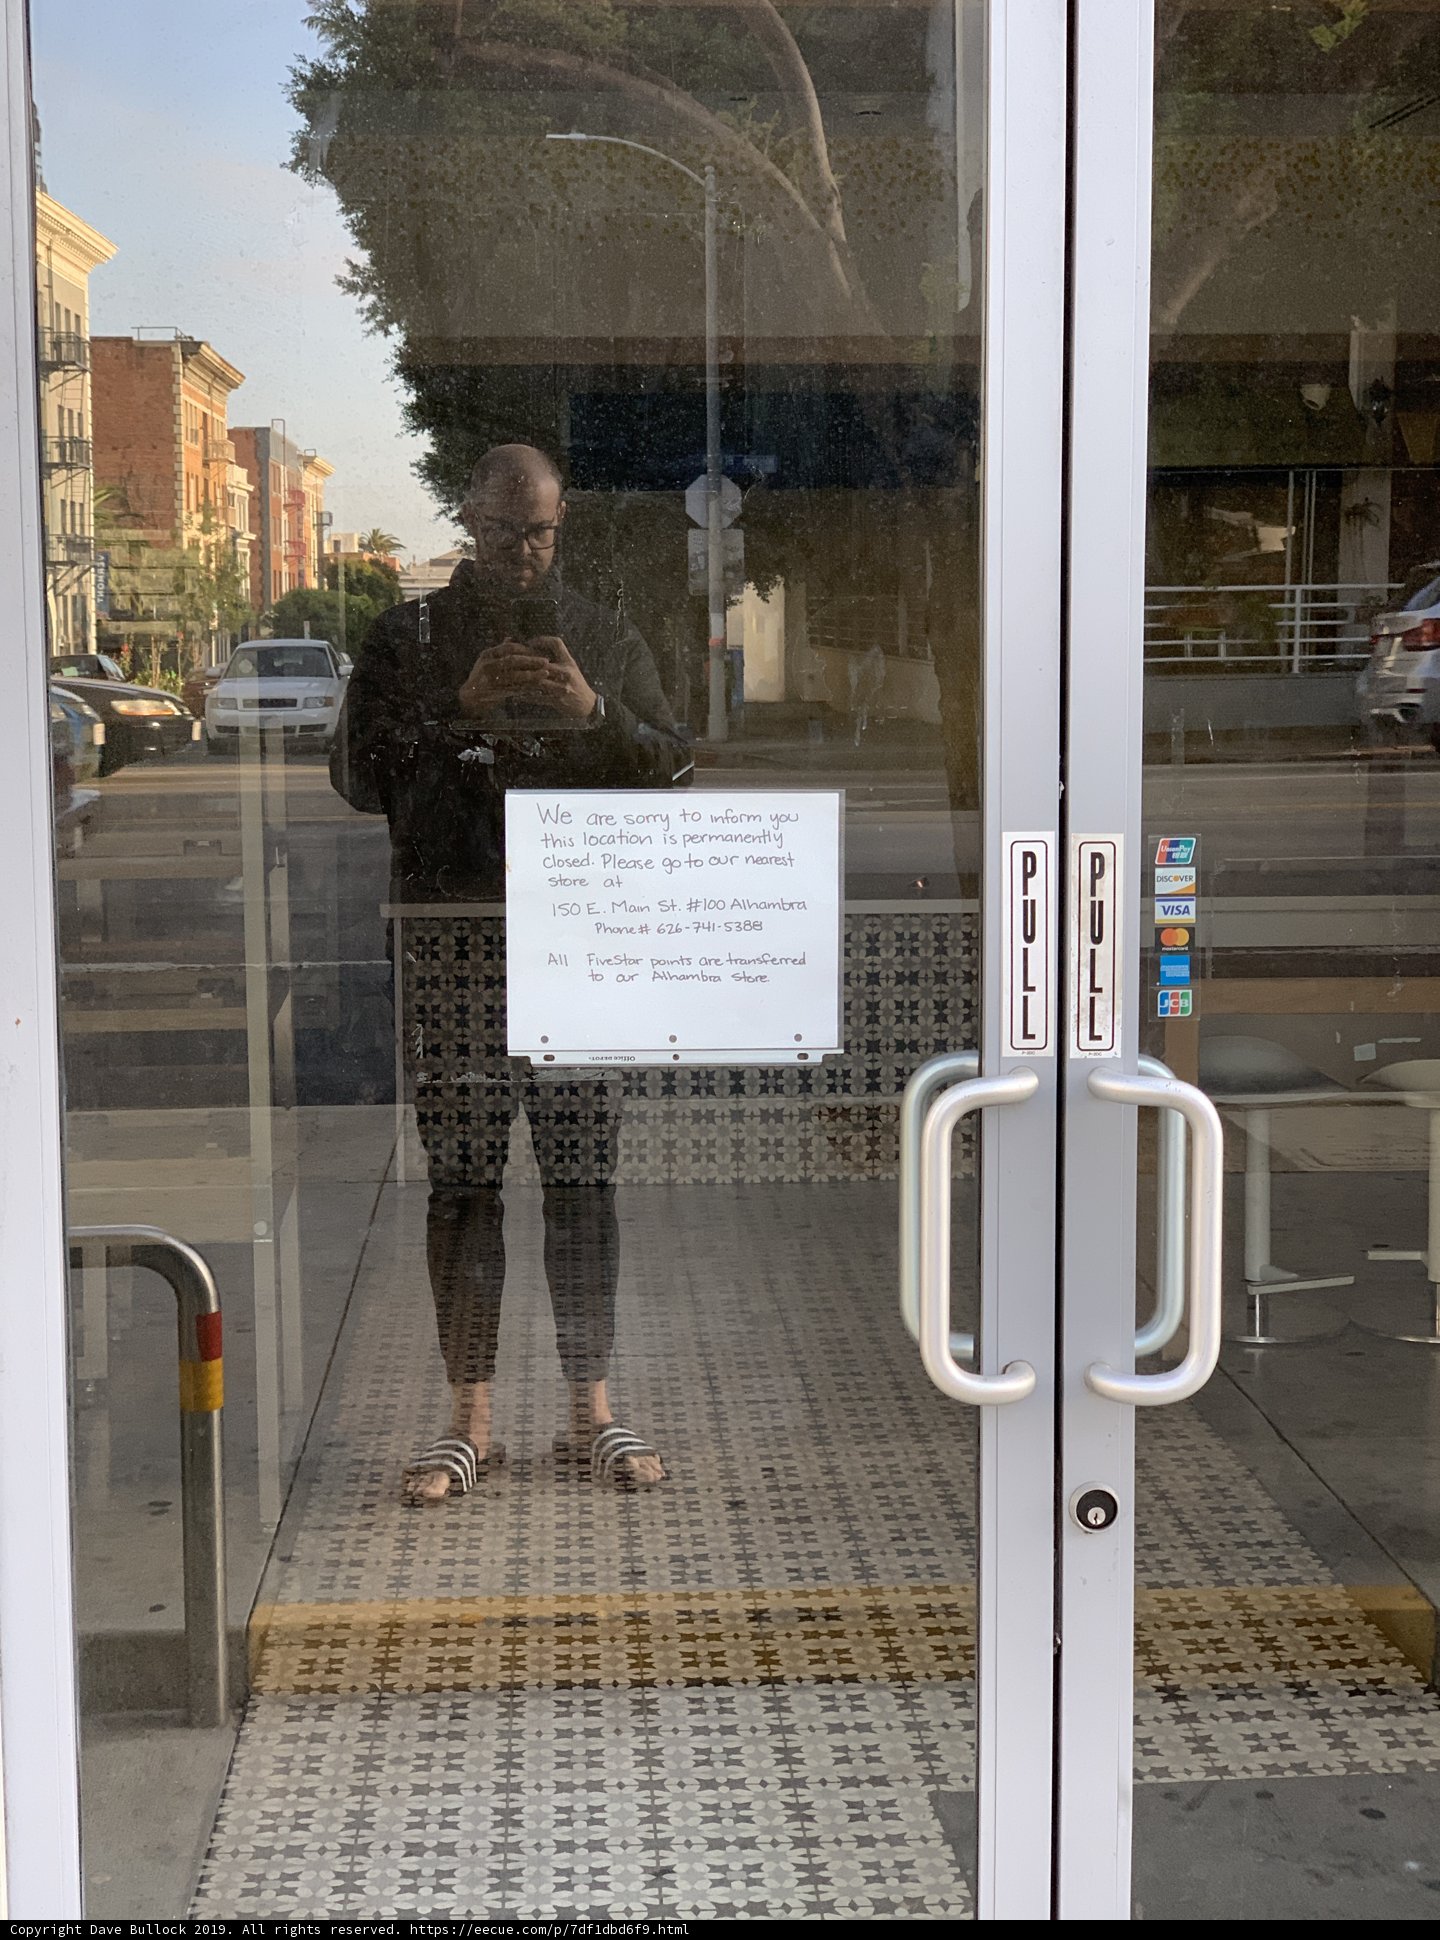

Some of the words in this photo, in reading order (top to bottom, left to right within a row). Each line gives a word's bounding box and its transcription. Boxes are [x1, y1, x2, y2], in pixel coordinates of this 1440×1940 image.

[536, 802, 573, 825] We
[586, 812, 617, 826] are
[623, 813, 670, 832] sorry
[679, 808, 702, 823] to
[710, 808, 762, 824] inform
[769, 812, 799, 831] you
[540, 832, 575, 849] this
[583, 828, 653, 847] location
[663, 833, 678, 845] is
[682, 829, 783, 849] permanently
[1160, 845, 1192, 853] UnionPay
[600, 853, 655, 870] Please
[661, 856, 682, 875] go
[684, 853, 704, 868] to
[708, 855, 740, 866] our
[745, 851, 796, 867] nearest
[548, 873, 590, 888] store
[603, 874, 624, 888] at
[1156, 875, 1194, 883] DISCOVER
[552, 902, 582, 917] 150
[586, 902, 607, 915] E.
[611, 899, 651, 914] Main
[657, 898, 682, 913] St.
[686, 897, 726, 913] #100
[730, 897, 808, 911] Alhambra
[1161, 905, 1191, 916] VISA
[656, 919, 764, 935] 626-741-5388
[1022, 850, 1037, 1040] PULL
[1089, 851, 1105, 1041] PULL
[547, 952, 569, 967] All
[649, 955, 693, 970] points
[698, 956, 724, 967] are
[725, 951, 807, 966] transferred
[588, 968, 605, 982] to
[615, 973, 640, 983] our
[651, 969, 722, 983] Alhambra
[1160, 999, 1189, 1008] JCB
